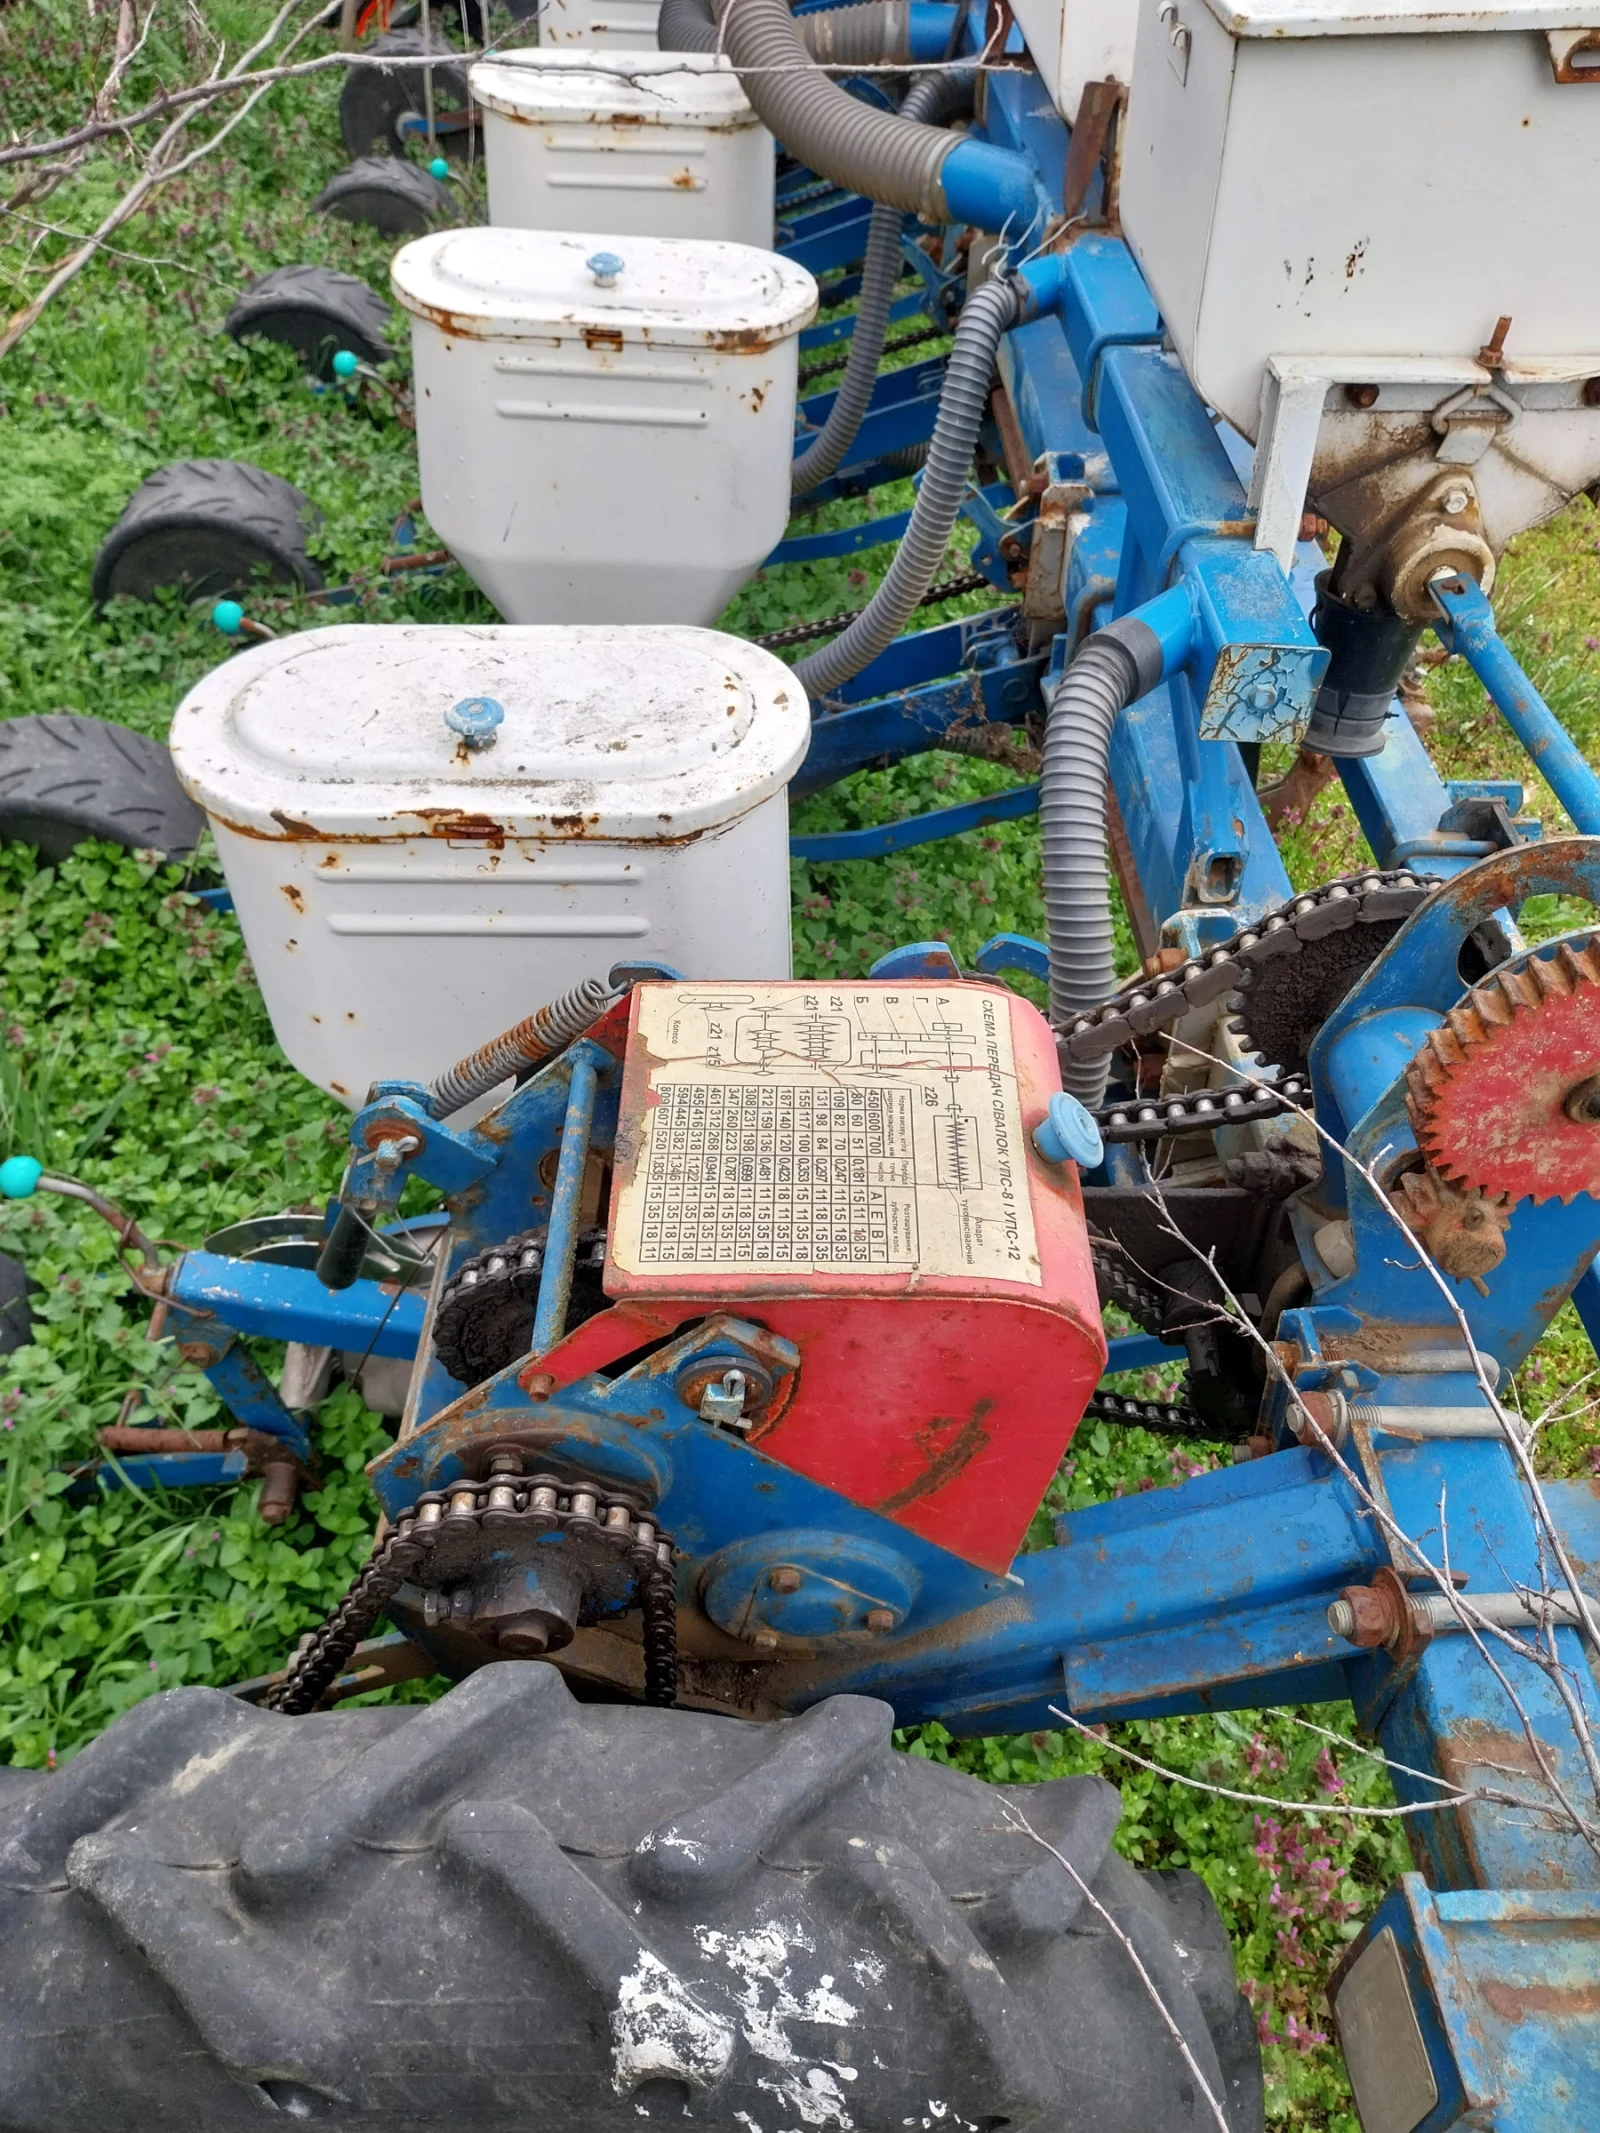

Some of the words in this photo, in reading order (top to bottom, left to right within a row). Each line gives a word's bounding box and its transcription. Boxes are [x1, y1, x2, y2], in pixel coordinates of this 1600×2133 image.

[805, 995, 819, 1011] z21
[830, 995, 843, 1012] z21
[856, 996, 869, 1004] Б
[886, 996, 899, 1004] В
[937, 997, 950, 1005] А
[982, 999, 995, 1039] СХЕМА
[710, 1023, 723, 1040] z21
[986, 1040, 1003, 1098] ПЕРЕДАЧ
[677, 1087, 689, 1105] 594
[692, 1087, 705, 1105] 495
[710, 1087, 722, 1104] 461
[728, 1088, 740, 1106] 347
[745, 1088, 757, 1106] 308
[762, 1088, 774, 1106] 212
[780, 1089, 792, 1107] 187
[799, 1089, 810, 1107] 155
[816, 1089, 828, 1106] 131
[833, 1090, 845, 1108] 109
[867, 1089, 882, 1109] 450
[925, 1086, 939, 1107] z26
[657, 1108, 670, 1126] 607
[674, 1108, 687, 1127] 445
[692, 1108, 704, 1128] 416
[709, 1109, 721, 1128] 312
[726, 1109, 739, 1128] 260
[744, 1110, 756, 1127] 231
[761, 1110, 773, 1129] 159
[779, 1111, 791, 1129] 140
[799, 1111, 811, 1129] 117
[816, 1113, 828, 1126] 98
[834, 1114, 846, 1127] 82
[851, 1114, 864, 1127] 60
[868, 1111, 883, 1131] 600
[993, 1099, 1009, 1156] СІВАЛОК
[655, 1131, 668, 1150] 520
[673, 1131, 685, 1150] 382
[690, 1131, 703, 1150] 318
[707, 1131, 720, 1151] 268
[725, 1131, 738, 1151] 223
[743, 1133, 755, 1152] 198
[760, 1133, 773, 1152] 136
[780, 1133, 792, 1152] 120
[798, 1134, 810, 1153] 100
[816, 1137, 828, 1150] 84
[834, 1138, 846, 1151] 70
[852, 1137, 864, 1149] 51
[869, 1133, 883, 1154] 700
[704, 1156, 718, 1182] 0,944
[724, 1156, 737, 1182] 0,787
[740, 1157, 754, 1182] 0,699
[758, 1157, 772, 1181] 0,481
[777, 1157, 791, 1182] 0,423
[796, 1158, 810, 1182] 0,353
[813, 1158, 828, 1183] 0,297
[833, 1158, 847, 1183] 0,247
[851, 1158, 866, 1183] 0,181
[999, 1160, 1014, 1200] УПС-8
[650, 1185, 663, 1199] 15
[668, 1186, 681, 1197] 11
[686, 1185, 698, 1197] 11
[704, 1185, 717, 1199] 15
[723, 1186, 735, 1199] 18
[740, 1187, 753, 1198] 11
[759, 1187, 771, 1198] 11
[778, 1187, 790, 1200] 18
[796, 1187, 809, 1200] 15
[815, 1188, 828, 1200] 11
[834, 1189, 847, 1200] 11
[853, 1189, 865, 1202] 15
[870, 1191, 883, 1200] А
[648, 1205, 661, 1219] 35
[666, 1205, 680, 1219] 35
[684, 1205, 697, 1219] 35
[702, 1205, 715, 1218] 18
[721, 1205, 734, 1219] 15
[739, 1205, 752, 1218] 18
[758, 1206, 771, 1220] 15
[778, 1207, 790, 1219] 11
[796, 1208, 809, 1220] 11
[815, 1207, 828, 1220] 18
[834, 1207, 847, 1220] 15
[853, 1207, 866, 1218] 11
[646, 1225, 659, 1239] 18
[665, 1225, 678, 1239] 18
[683, 1225, 696, 1239] 15
[701, 1224, 714, 1239] 35
[721, 1224, 734, 1239] 35
[738, 1224, 751, 1239] 35
[757, 1224, 770, 1239] 35
[777, 1225, 790, 1239] 35
[796, 1225, 809, 1240] 35
[815, 1227, 828, 1241] 15
[834, 1227, 848, 1242] 18
[871, 1230, 884, 1239] В
[974, 1217, 984, 1247] Апарат
[1004, 1211, 1021, 1261] УПС-12
[644, 1247, 657, 1258] 11
[662, 1245, 675, 1259] 15
[681, 1245, 694, 1259] 18
[700, 1246, 713, 1258] 11
[720, 1246, 732, 1258] 11
[737, 1243, 750, 1258] 15
[756, 1245, 769, 1259] 18
[776, 1244, 789, 1258] 15
[795, 1246, 809, 1259] 18
[816, 1246, 829, 1260] 35
[835, 1246, 848, 1260] 35
[854, 1246, 867, 1260] 35
[872, 1250, 885, 1258] Г
